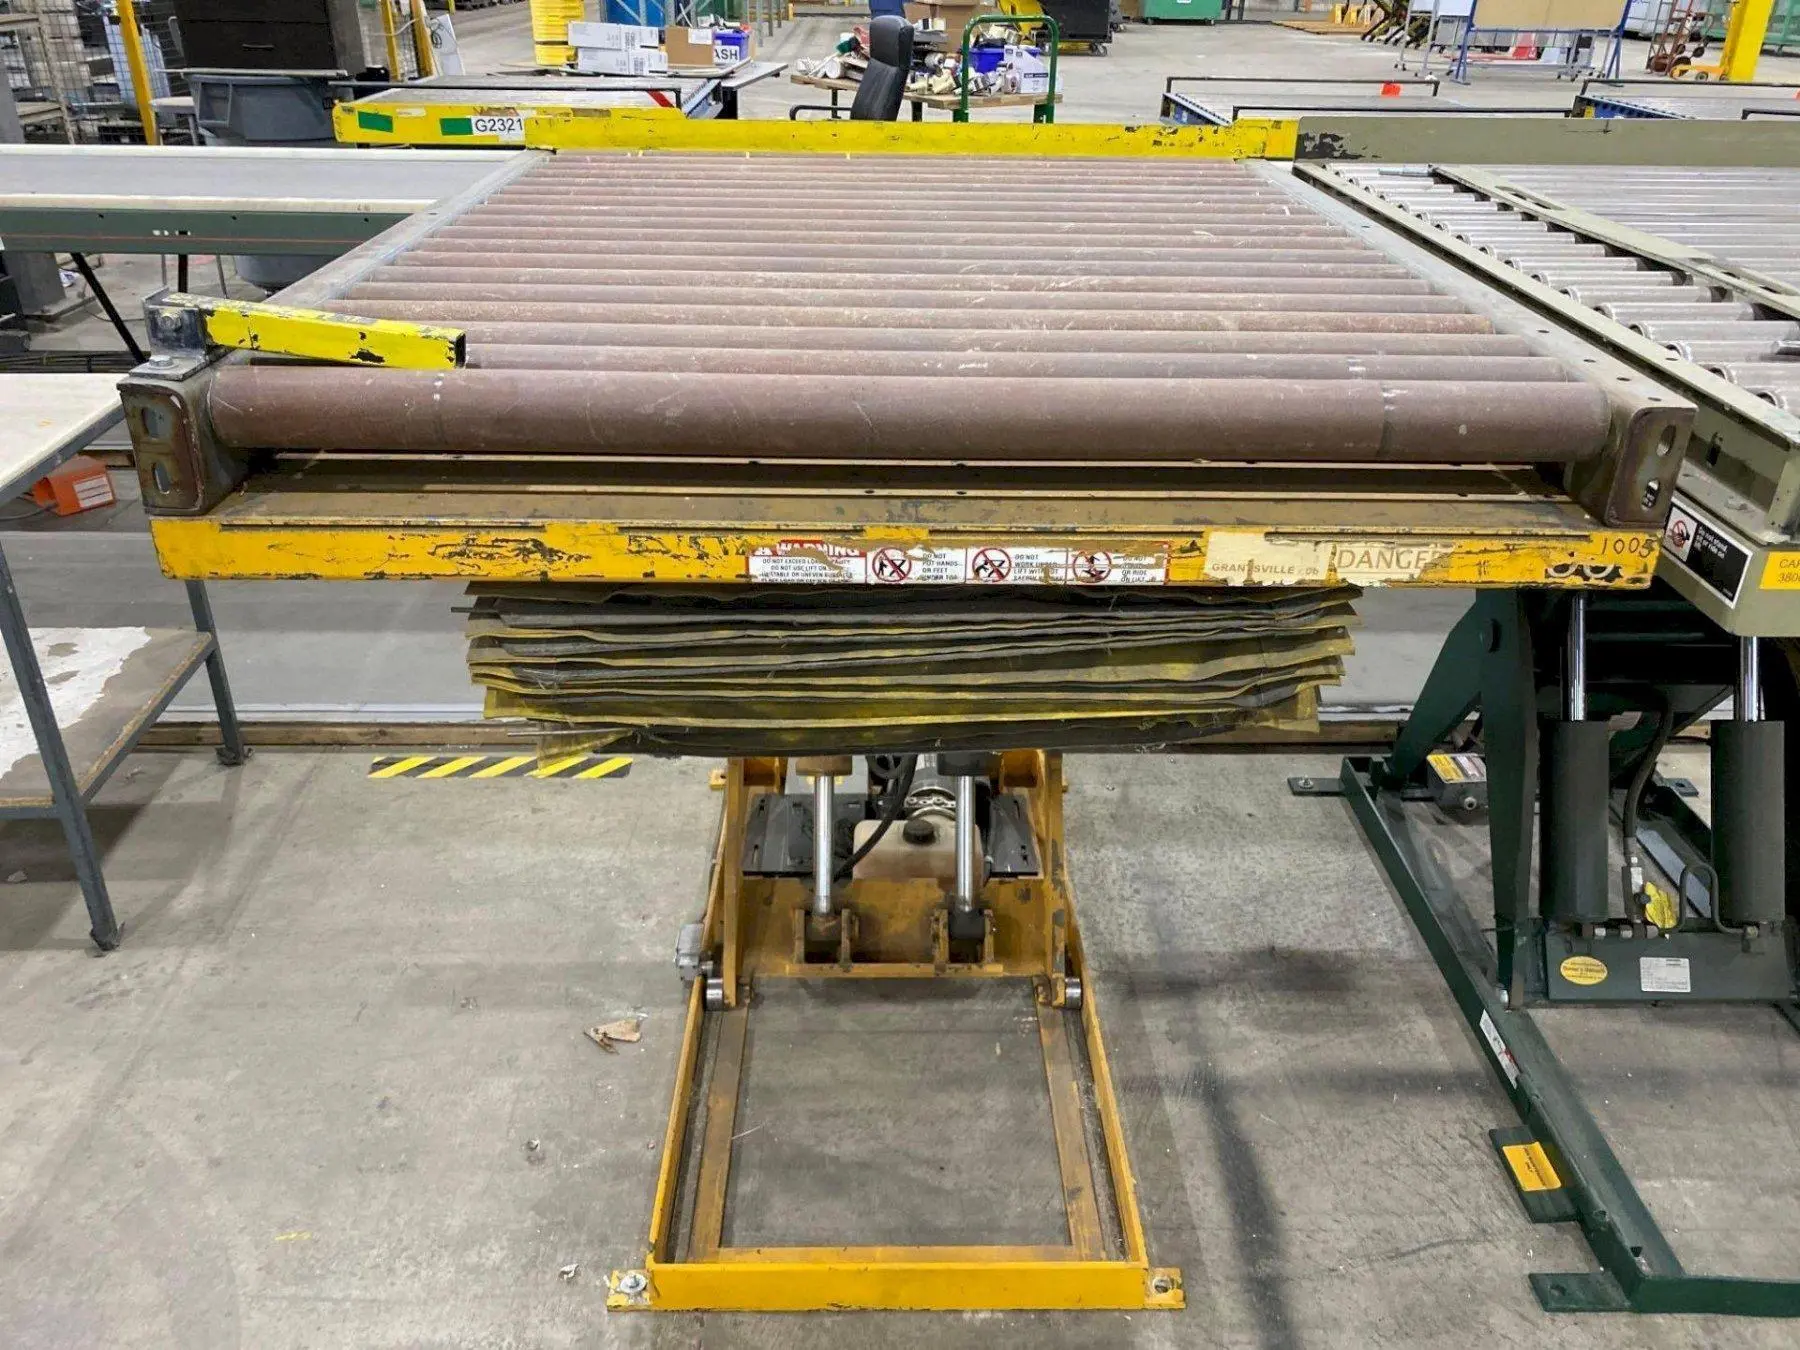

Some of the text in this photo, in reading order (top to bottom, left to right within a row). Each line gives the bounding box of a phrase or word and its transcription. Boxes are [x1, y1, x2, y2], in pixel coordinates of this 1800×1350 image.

[475, 118, 523, 133] G2321
[1337, 549, 1442, 570] DANGE
[1211, 563, 1295, 574] GRANSVILLE
